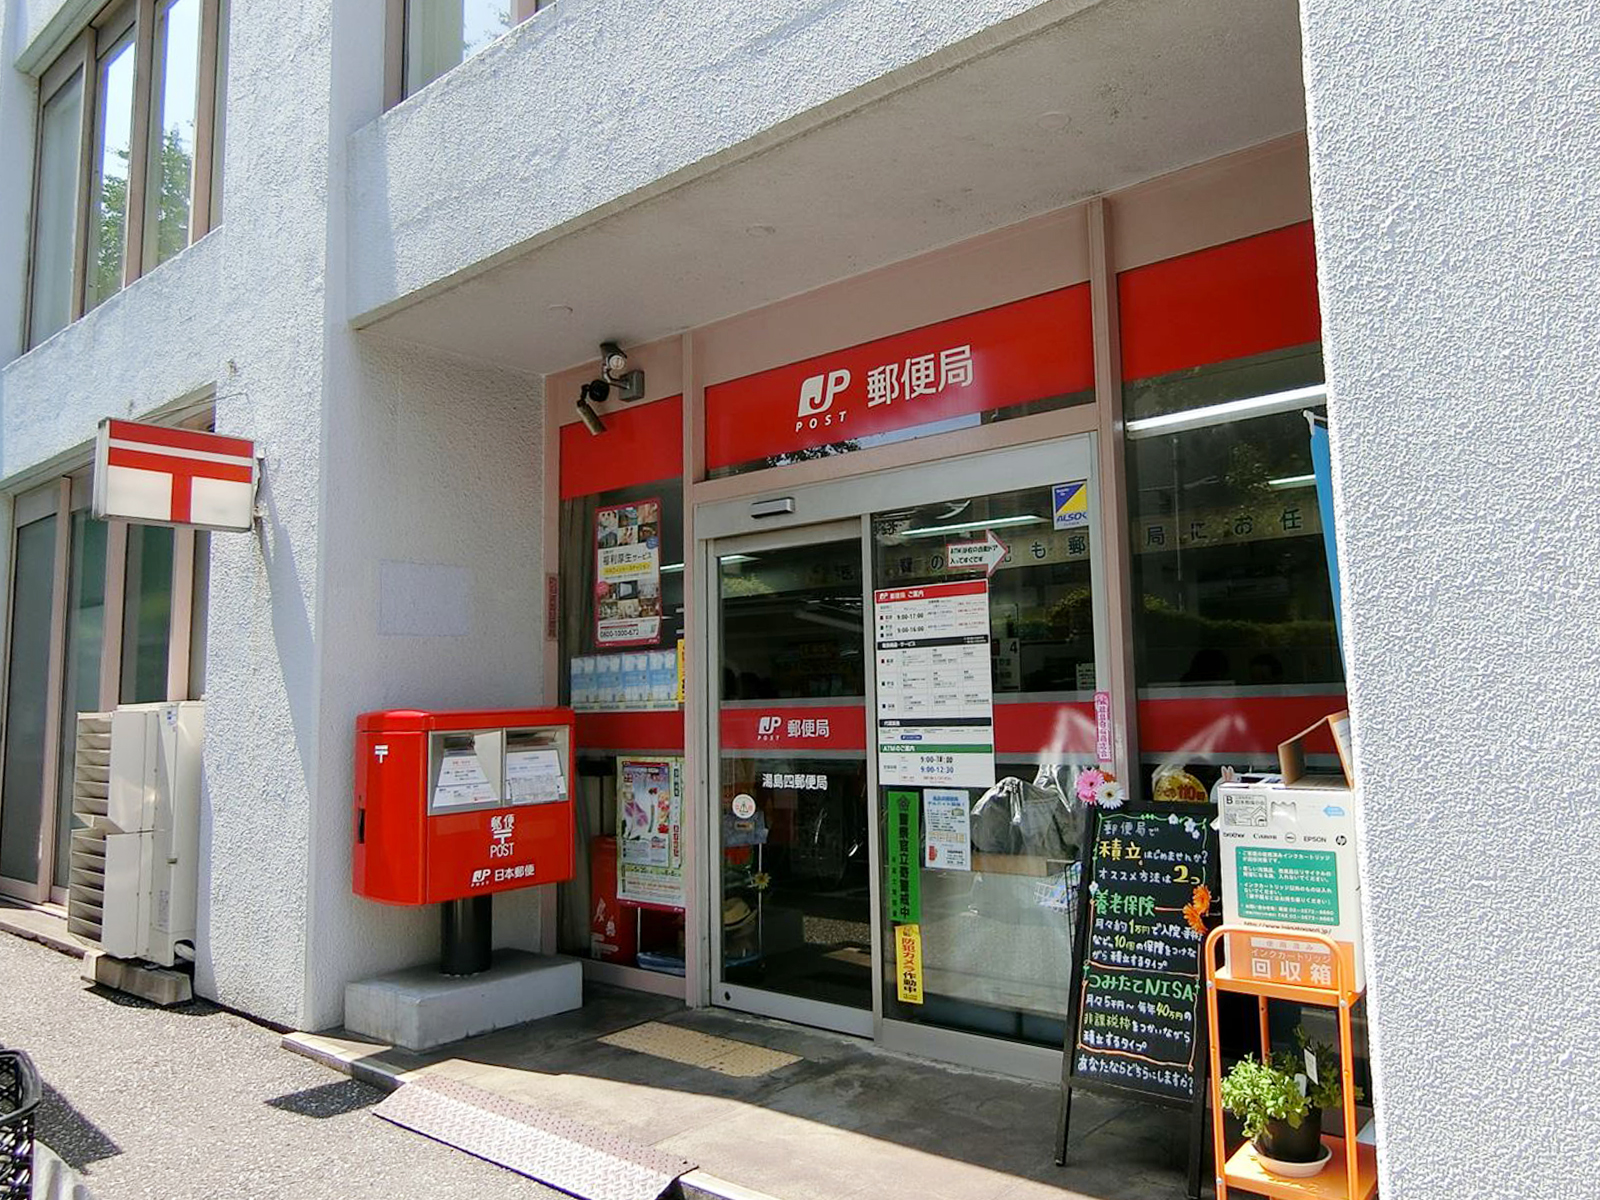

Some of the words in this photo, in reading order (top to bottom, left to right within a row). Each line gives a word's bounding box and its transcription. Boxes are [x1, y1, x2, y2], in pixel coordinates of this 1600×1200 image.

[867, 344, 974, 408] 郵便局
[795, 411, 847, 432] POST
[1056, 511, 1088, 523] ALSOK
[603, 552, 653, 566] 福利厚生サービス
[908, 590, 924, 598] ご案内
[1009, 641, 1018, 654] 4
[787, 719, 830, 738] 郵便局
[762, 773, 828, 791] 湯島四郵便局
[491, 813, 515, 831] 郵便
[1103, 820, 1159, 837] 郵便局で
[1223, 831, 1245, 839] brother
[1253, 833, 1278, 841] Canon
[1303, 835, 1328, 844] EPSON
[489, 843, 515, 858] POST
[495, 864, 535, 882] 日本郵便
[1099, 865, 1200, 885] オススメ方法は2つ
[1095, 889, 1156, 917] 養老保険
[1092, 950, 1168, 970] がら積立するタイプ
[1251, 948, 1331, 963] インクカートリッジ
[902, 938, 917, 994] 防犯カメラ作動中
[1251, 958, 1331, 985] 回収箱
[1089, 974, 1194, 1002] つみたてNISA
[1084, 1012, 1191, 1043] 非課税枠をつかいながら
[1083, 1029, 1147, 1051] 積立するタイプ
